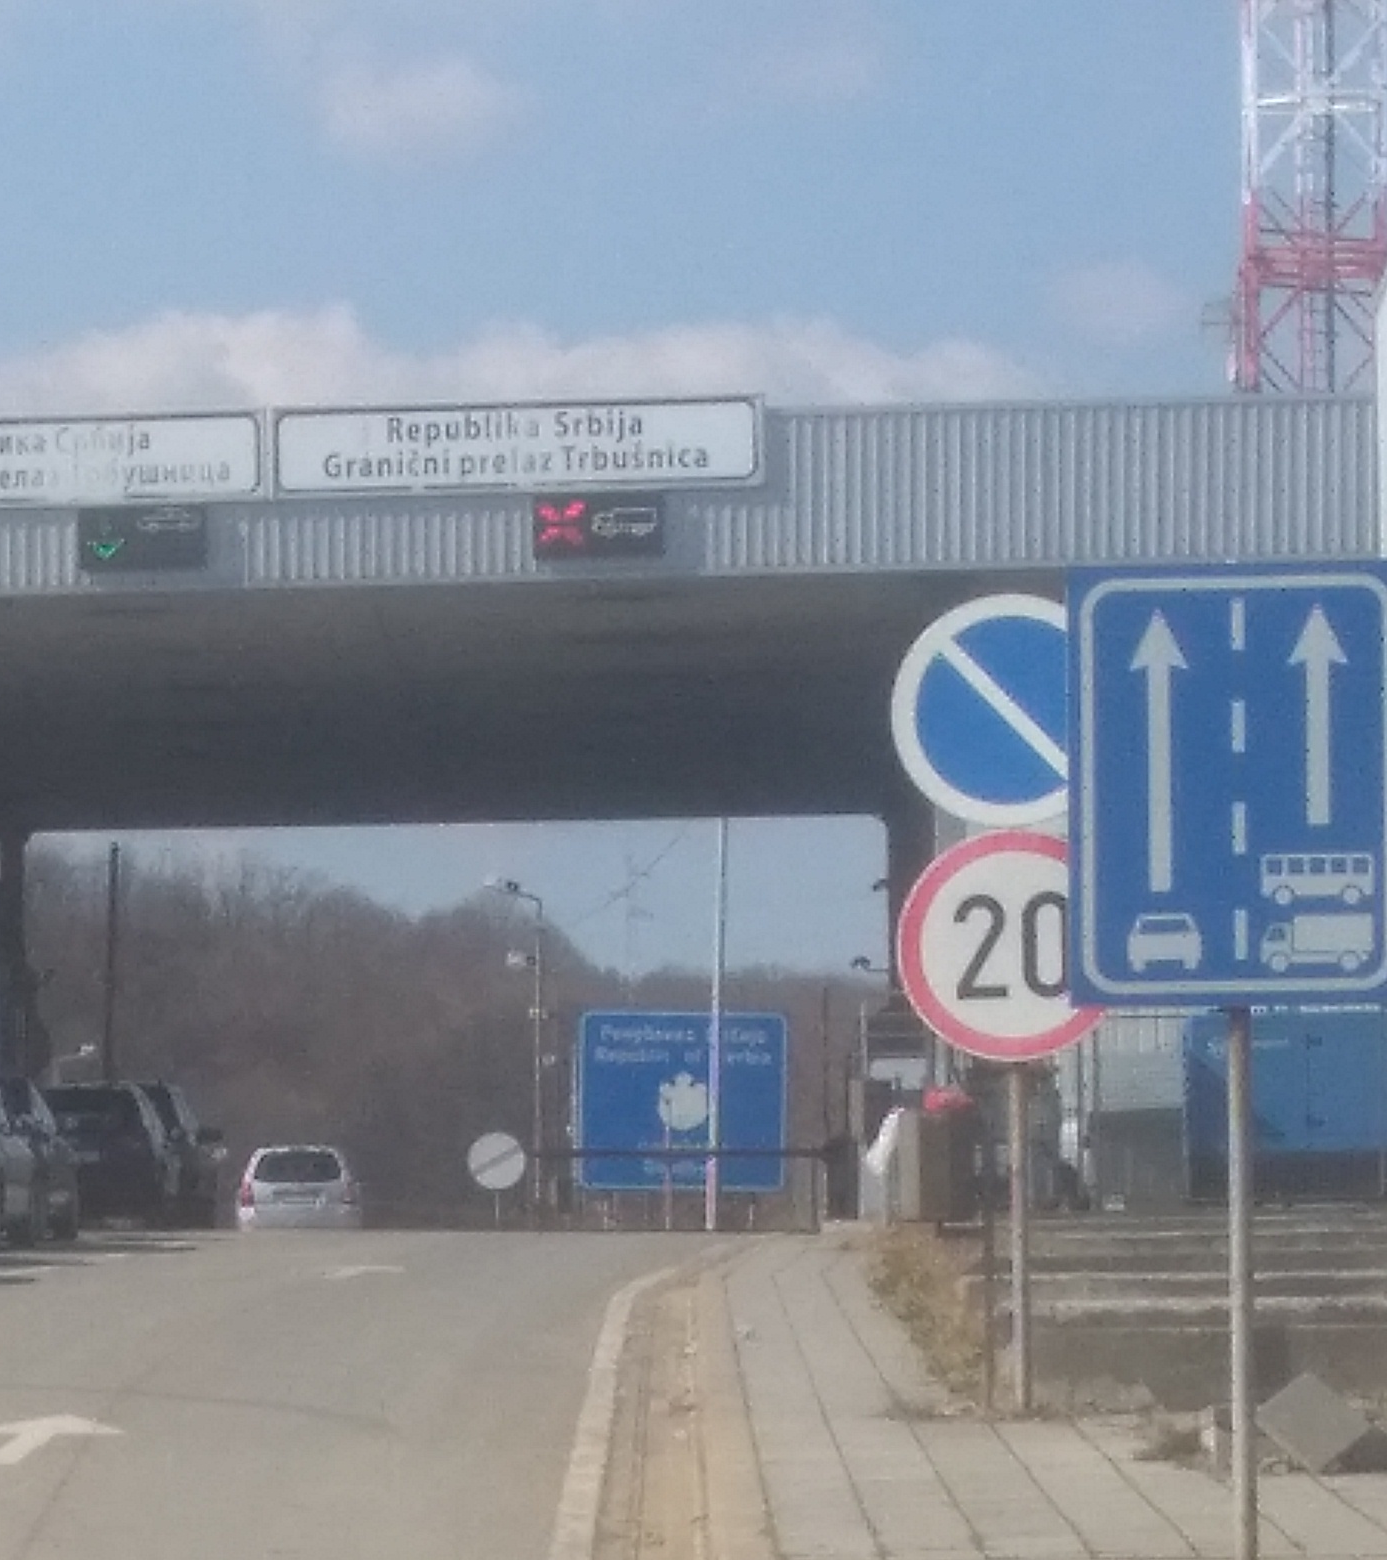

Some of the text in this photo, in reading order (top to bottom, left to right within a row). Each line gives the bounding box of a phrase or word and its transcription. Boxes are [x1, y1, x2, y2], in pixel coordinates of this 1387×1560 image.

[387, 409, 644, 446] Republika Srbija
[460, 447, 553, 478] prelaz
[559, 440, 711, 471] Trbušnica
[952, 891, 1068, 1001] 20
